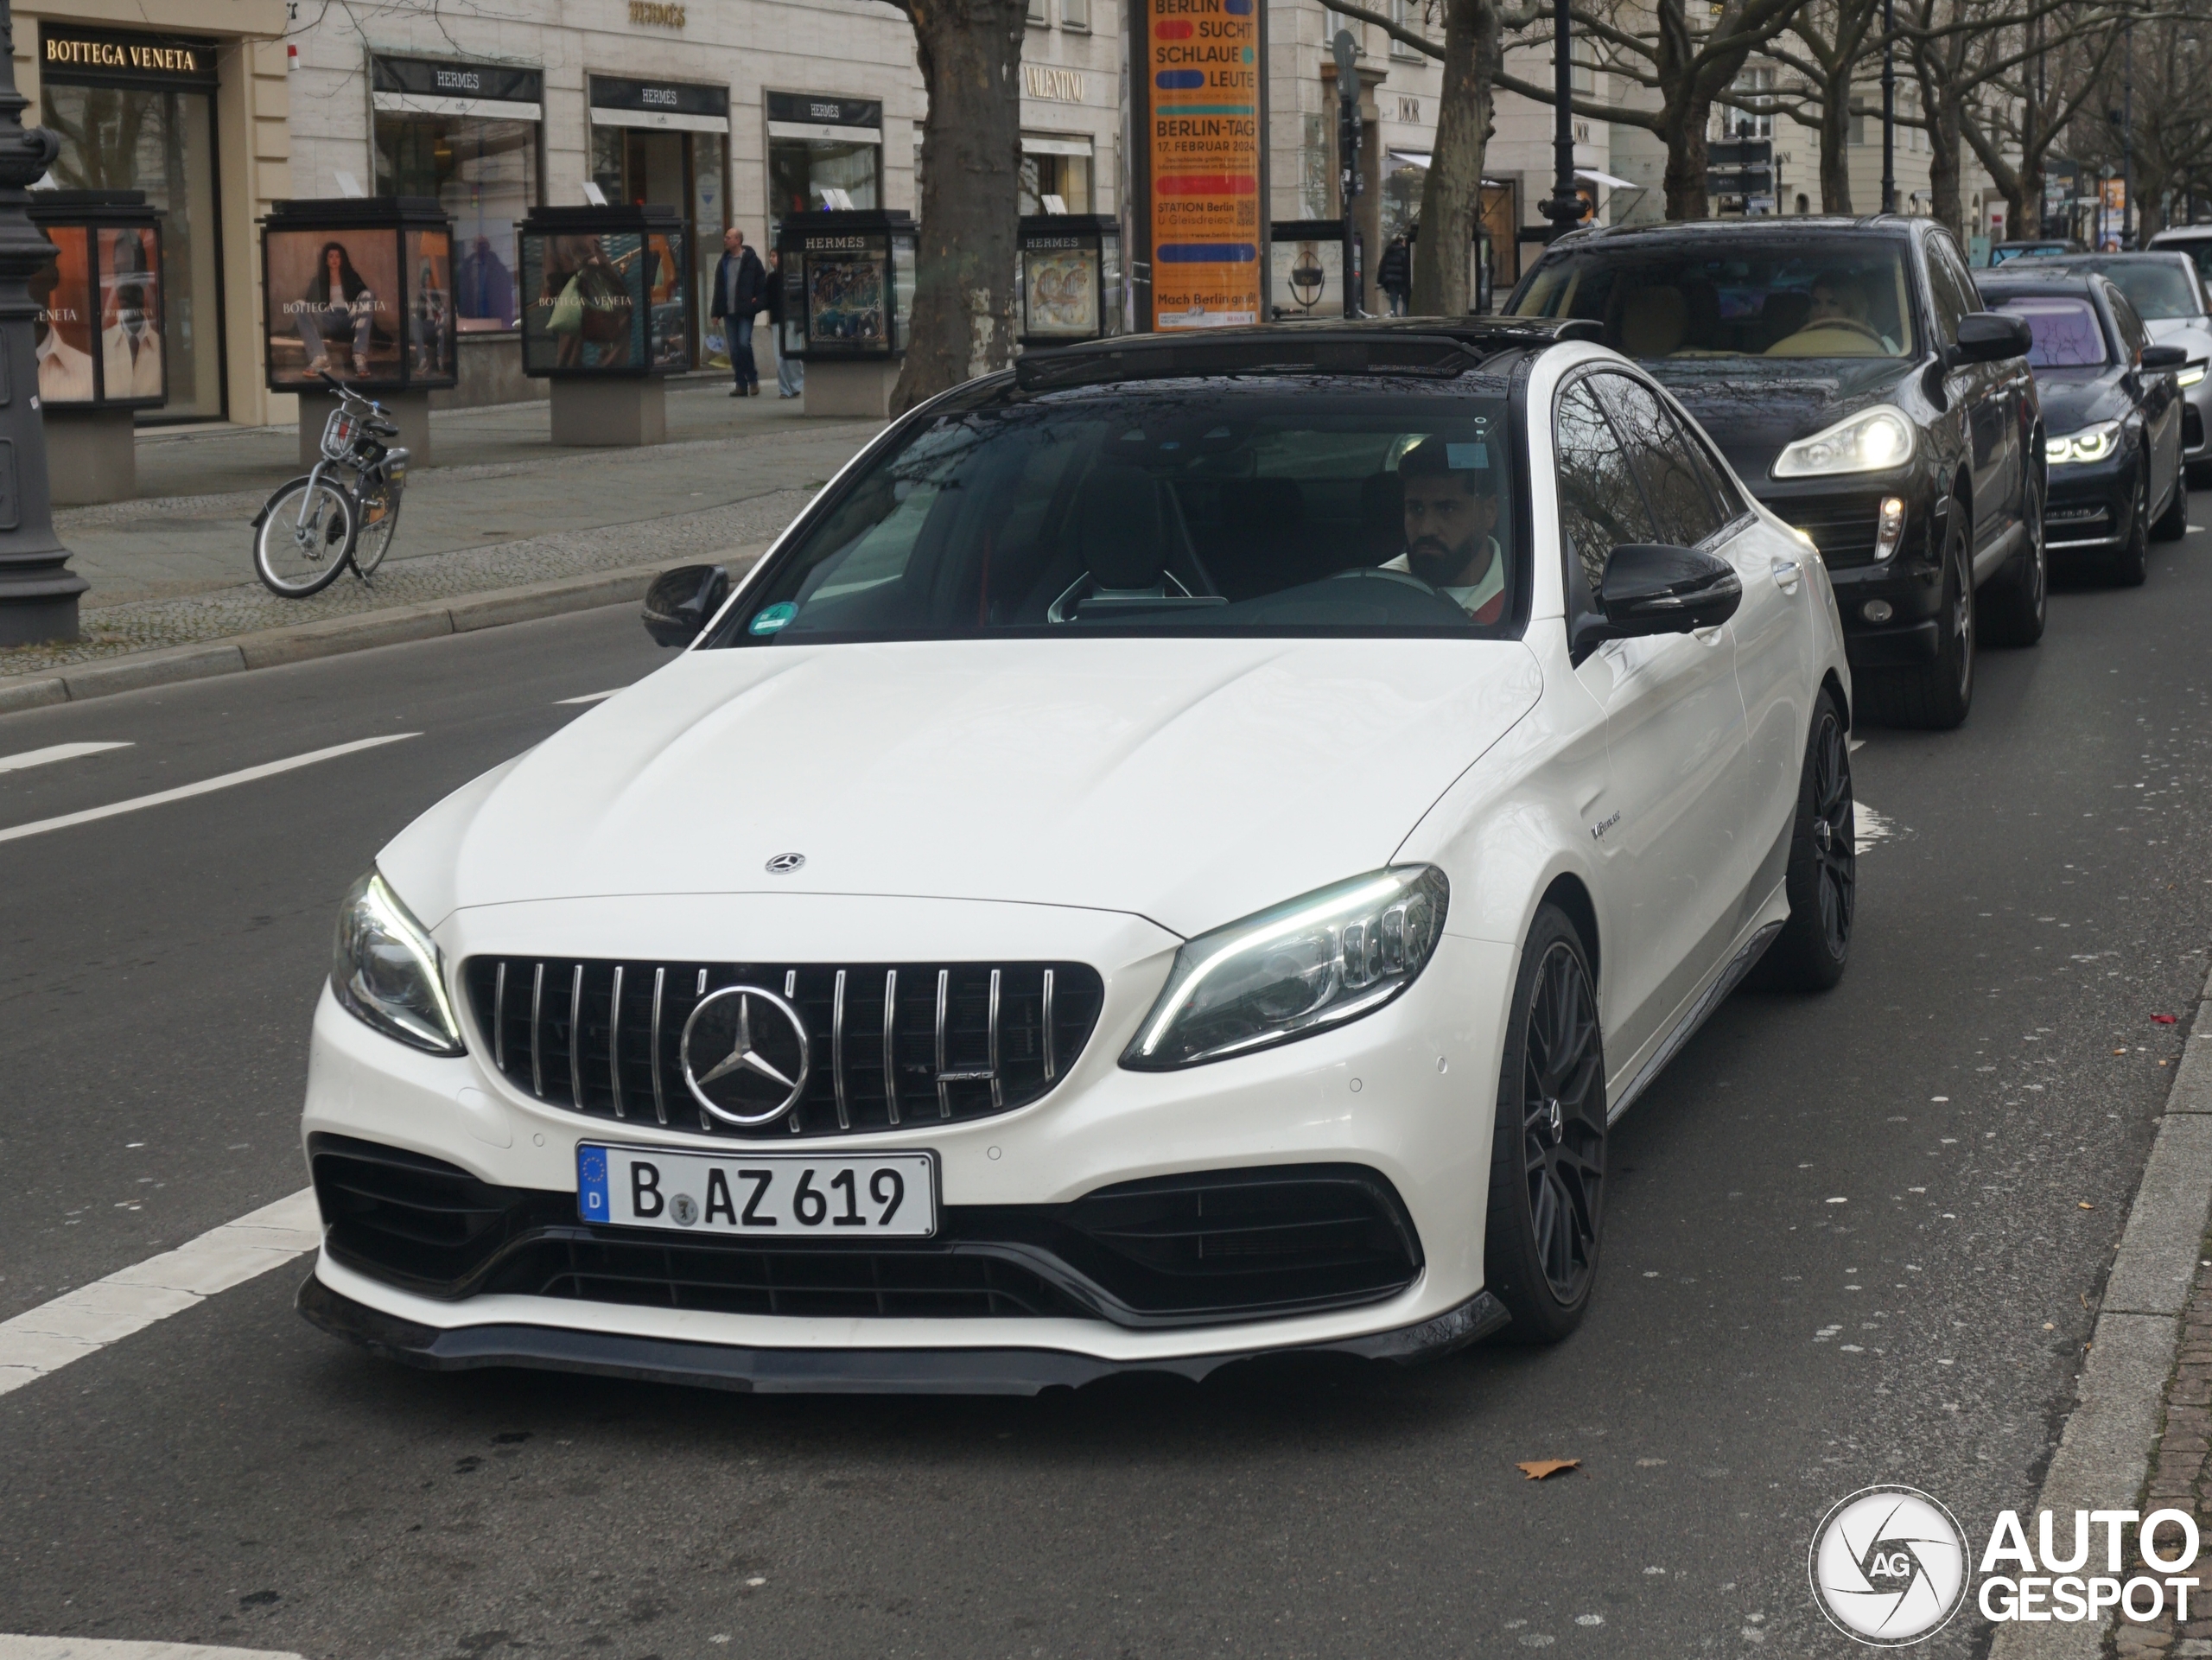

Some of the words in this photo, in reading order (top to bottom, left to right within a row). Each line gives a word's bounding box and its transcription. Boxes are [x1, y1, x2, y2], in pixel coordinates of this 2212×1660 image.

[1156, 0, 1219, 14] BERLIN
[1199, 21, 1253, 38] SUCHT
[47, 40, 125, 66] BOTTEGA
[130, 46, 194, 70] VENETA
[1156, 46, 1239, 63] SCHLAUE
[1024, 67, 1084, 101] VALENTINO
[1210, 71, 1254, 87] LEUTE
[1397, 96, 1420, 123] DIOR
[1157, 119, 1255, 137] BERLIN-TAG
[1573, 122, 1589, 143] DIOR
[1158, 141, 1171, 152] 17.
[1175, 141, 1229, 152] FEBRUAR
[1233, 140, 1255, 152] 2024
[1158, 202, 1204, 213] STATION
[1207, 201, 1234, 213] Berlin
[1169, 214, 1234, 225] Gleisdreieck
[283, 302, 334, 314] BOTTEGA
[346, 301, 386, 312] VENETA
[594, 296, 632, 306] VENETA
[1158, 293, 1190, 305] Mach
[1194, 293, 1229, 305] Berlin
[1231, 292, 1256, 307] groß!
[34, 308, 77, 321] ENETA
[588, 1191, 601, 1209] D
[630, 1161, 664, 1218] B
[705, 1167, 777, 1226] AZ
[792, 1167, 905, 1226] 619
